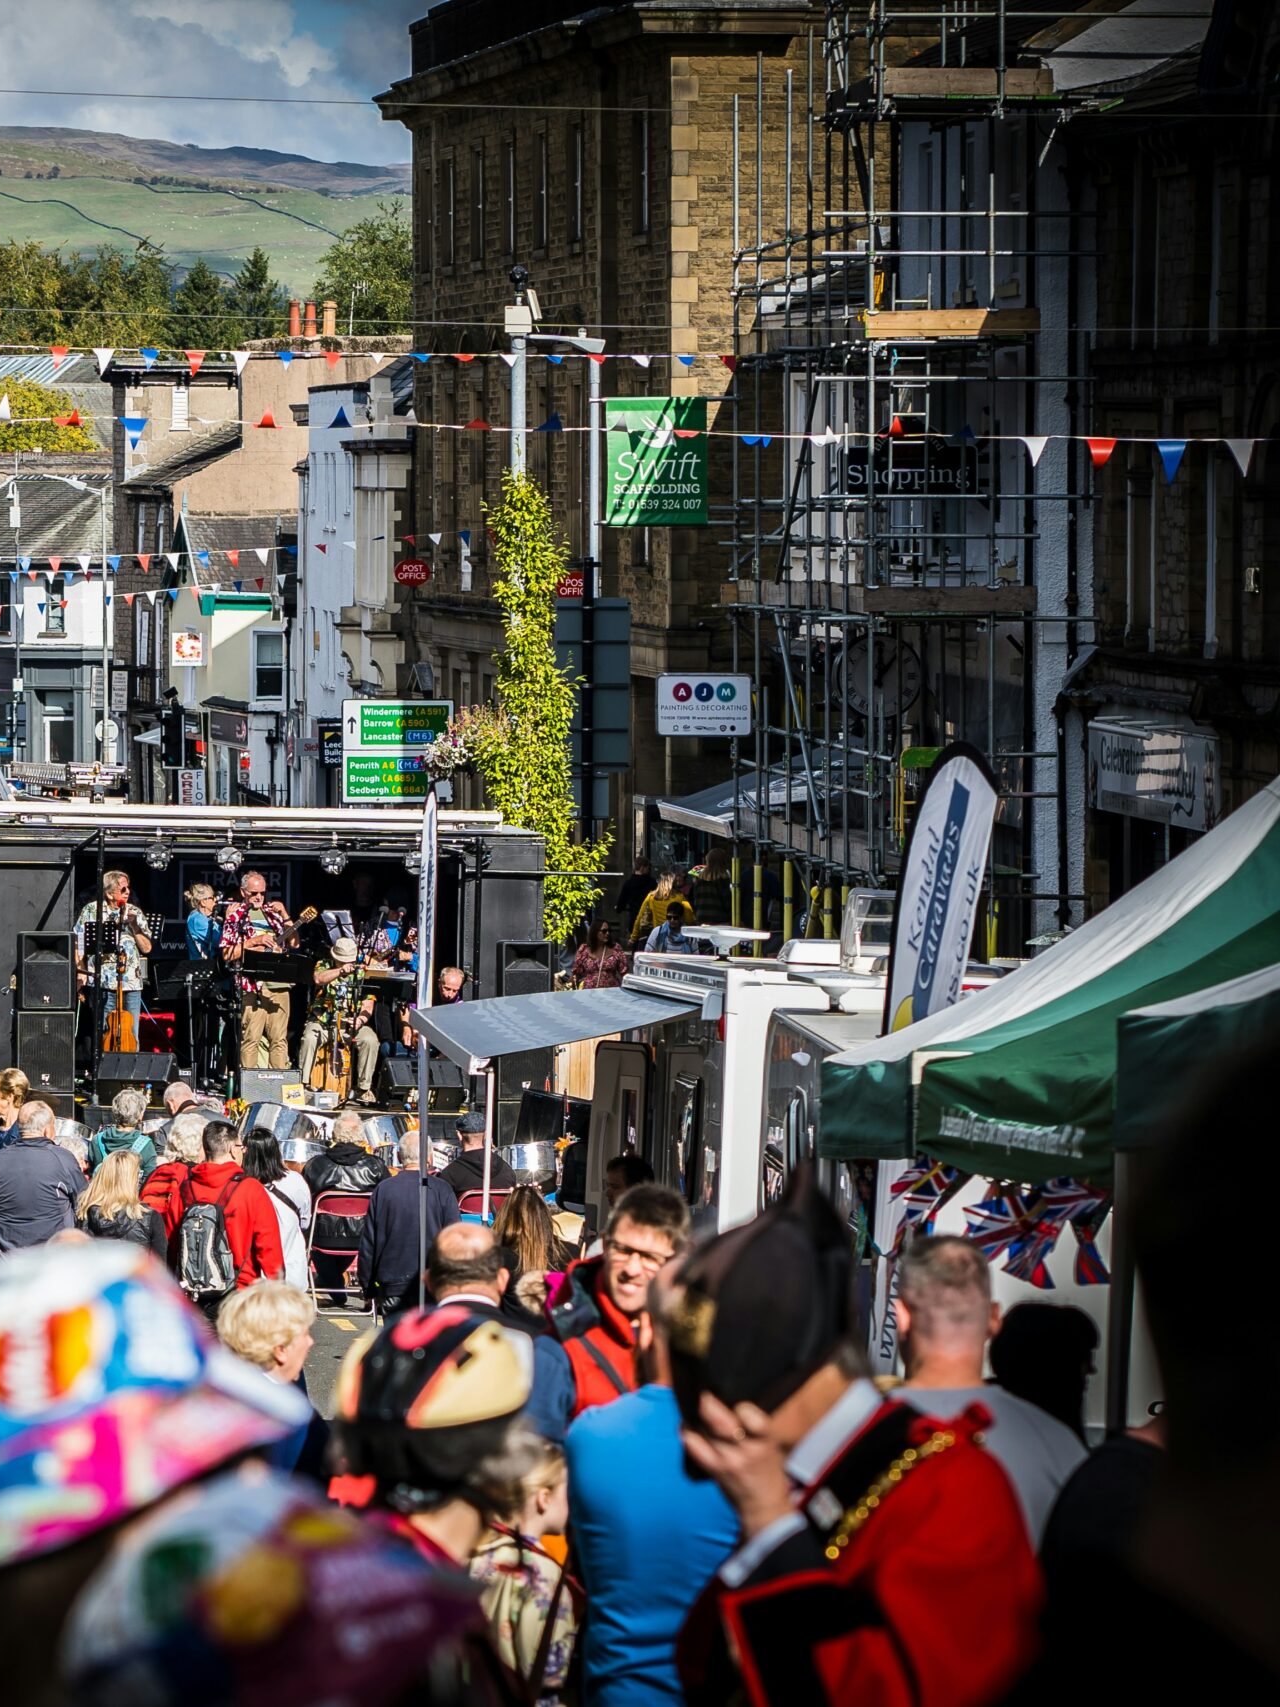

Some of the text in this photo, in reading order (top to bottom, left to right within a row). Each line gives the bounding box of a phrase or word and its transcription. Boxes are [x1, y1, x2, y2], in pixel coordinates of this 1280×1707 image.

[615, 451, 702, 480] Swift
[848, 465, 970, 489] Shopping
[613, 484, 701, 494] SCAFFOLDING
[628, 499, 659, 509] 01539
[662, 499, 680, 509] 324
[683, 499, 702, 509] 007
[402, 564, 424, 572] POST
[397, 572, 426, 580] OFFICE
[565, 578, 584, 587] POS
[559, 587, 584, 596] OFFIC
[363, 707, 447, 716] Windermere (A591)
[363, 719, 394, 728] Barrow
[363, 732, 404, 741] Lancaster
[349, 761, 380, 770] Penrith
[398, 761, 424, 770] (M6
[349, 774, 380, 783] Brough
[349, 786, 390, 795] Sedbergh
[907, 825, 941, 954] Kendal
[918, 819, 962, 991] Caravans
